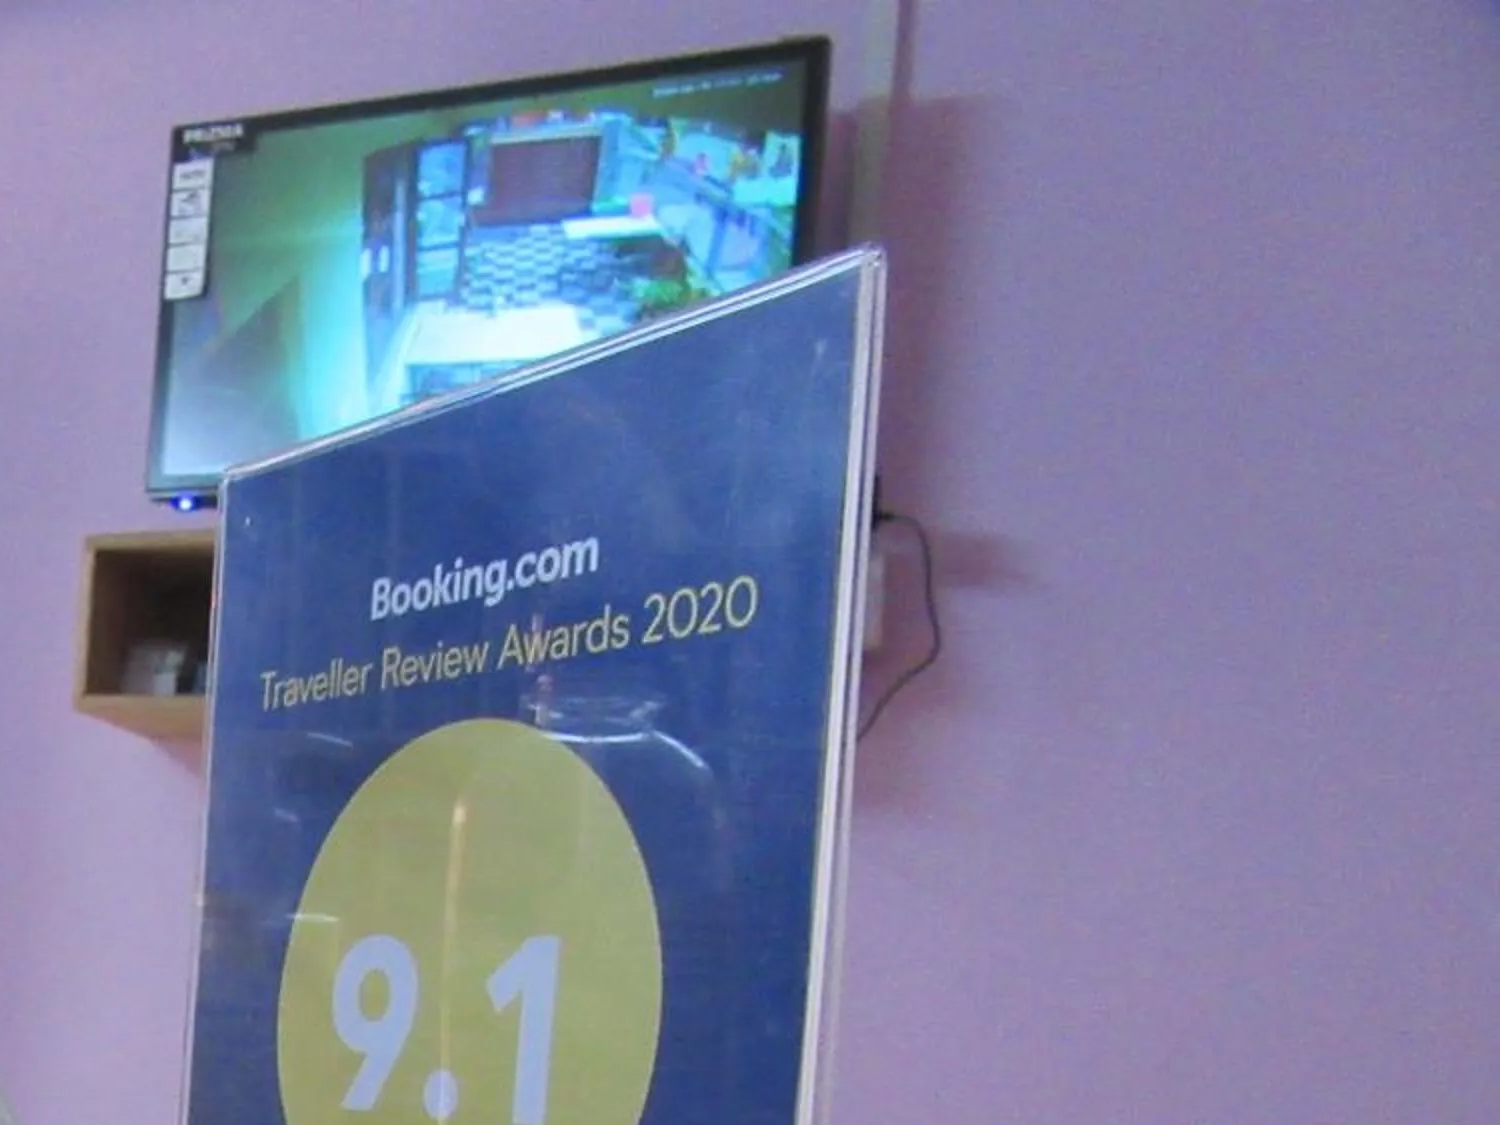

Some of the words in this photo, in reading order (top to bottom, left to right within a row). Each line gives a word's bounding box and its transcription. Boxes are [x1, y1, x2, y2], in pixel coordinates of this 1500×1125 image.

[369, 536, 600, 621] Booking.com
[260, 659, 374, 712] Traveller
[380, 640, 489, 691] Review
[498, 605, 630, 671] Awards
[641, 575, 758, 645] 2020
